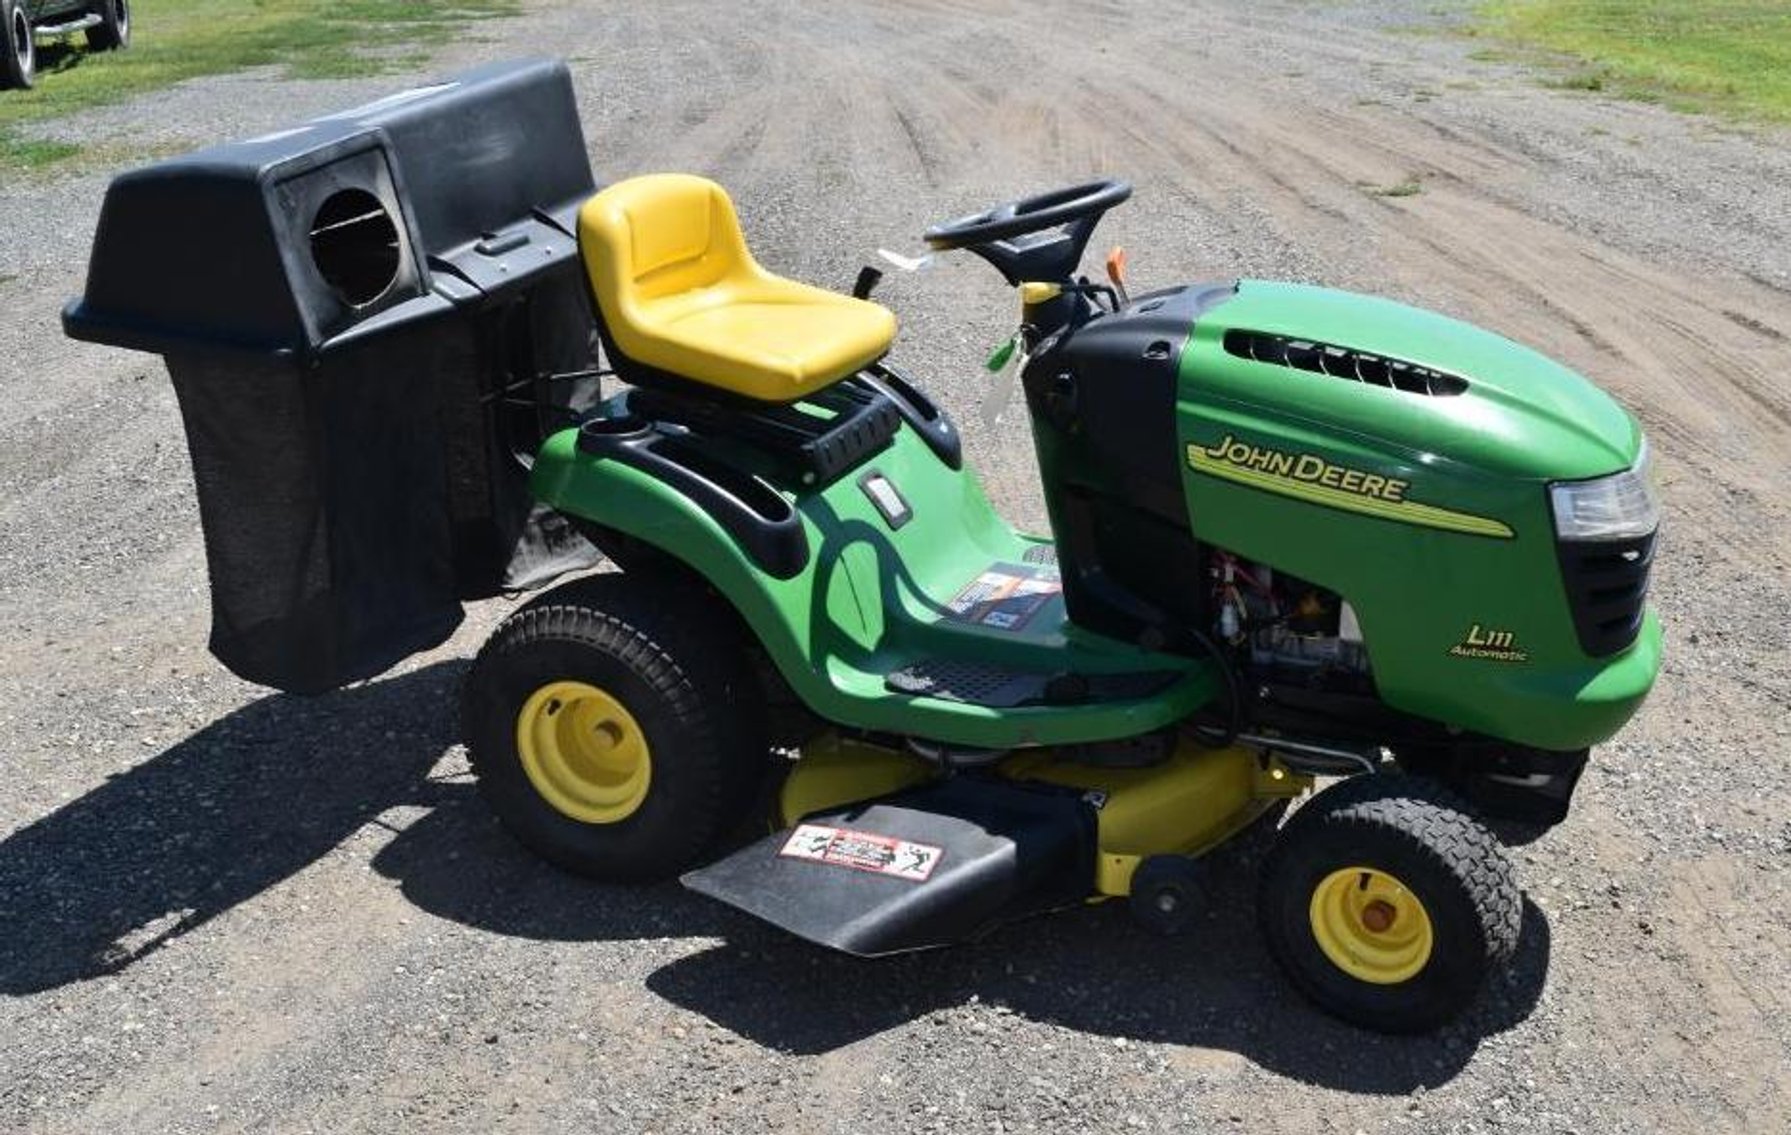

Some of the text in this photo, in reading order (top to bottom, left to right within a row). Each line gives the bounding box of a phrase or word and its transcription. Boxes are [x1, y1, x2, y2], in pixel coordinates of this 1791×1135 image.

[1207, 435, 1409, 501] JOHN DEERE
[1449, 645, 1529, 661] Automatic
